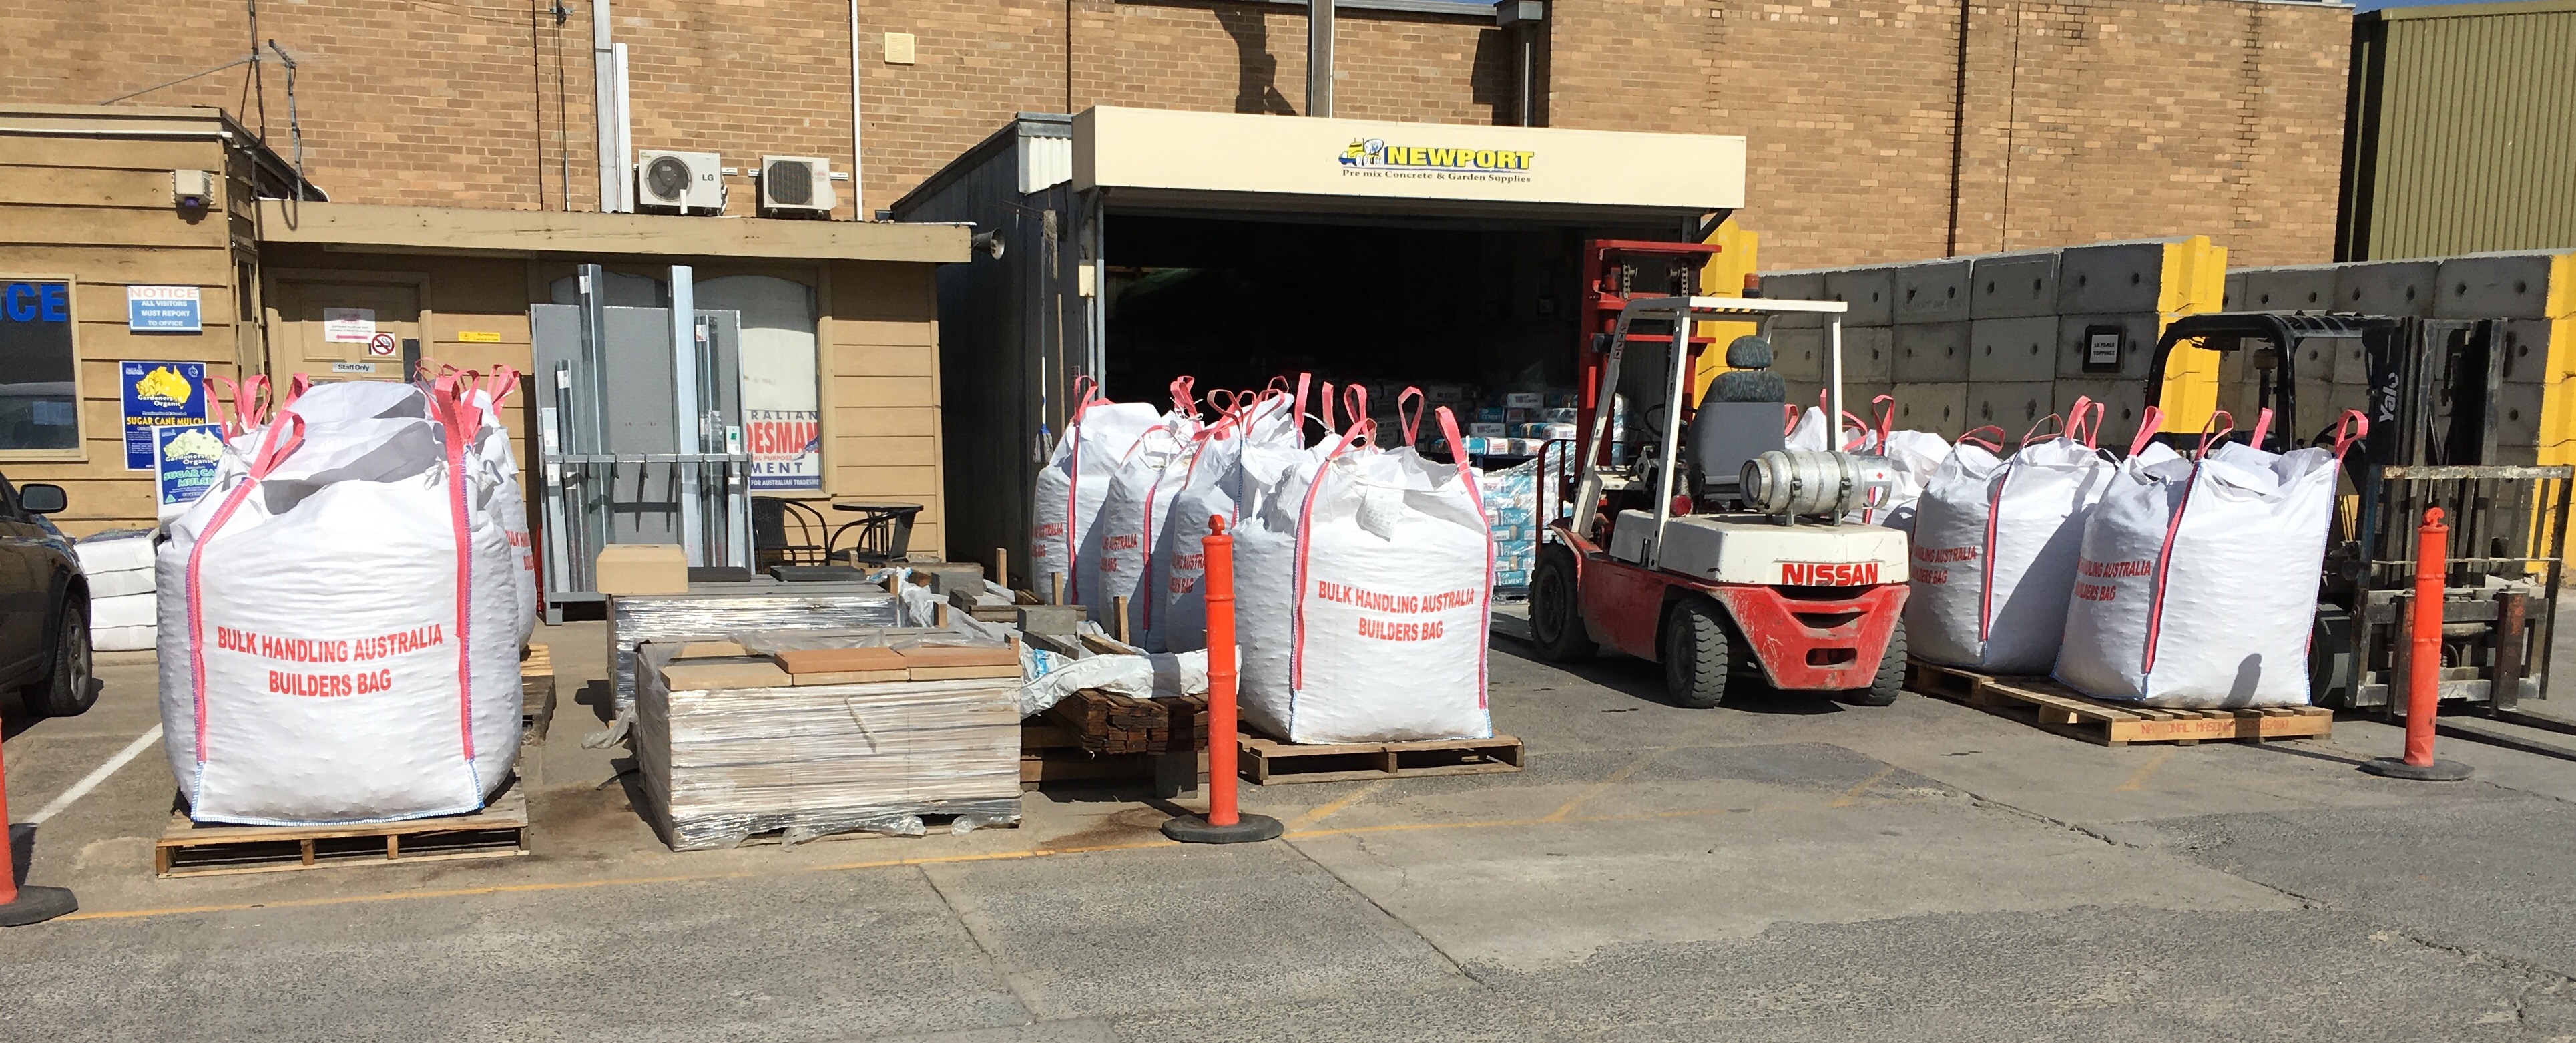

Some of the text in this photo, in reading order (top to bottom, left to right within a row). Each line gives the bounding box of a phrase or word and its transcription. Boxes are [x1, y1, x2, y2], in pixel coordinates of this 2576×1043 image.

[1384, 146, 1534, 169] NEWPORT
[1342, 169, 1360, 177] Pre
[1363, 170, 1382, 178] mix
[1385, 170, 1433, 180] Concrete
[1449, 172, 1485, 181] Garden
[1489, 174, 1531, 184] Supplies
[130, 288, 198, 298] NOTICE
[0, 283, 67, 321] CE
[354, 364, 370, 372] Only
[127, 417, 204, 425] SUGAR CANE MULCH
[751, 410, 817, 420] RALIAN
[746, 421, 818, 454] DESMAN
[163, 469, 216, 481] SUGAR CA
[752, 462, 802, 474] MENT
[1183, 554, 1204, 570] AUSTR
[1935, 546, 1977, 563] AUSTRALIA
[1782, 563, 1878, 586] NISSAN
[2103, 560, 2151, 578] AUSTRALIA
[1318, 580, 1475, 614] BULK HANDLING AUSTRALIA
[2099, 585, 2116, 601] BAG
[1358, 616, 1443, 642] BUILDERS BAG
[218, 624, 443, 663] BULK HANDLING AUSTRALIA
[269, 668, 391, 697] BUILDERS BAG
